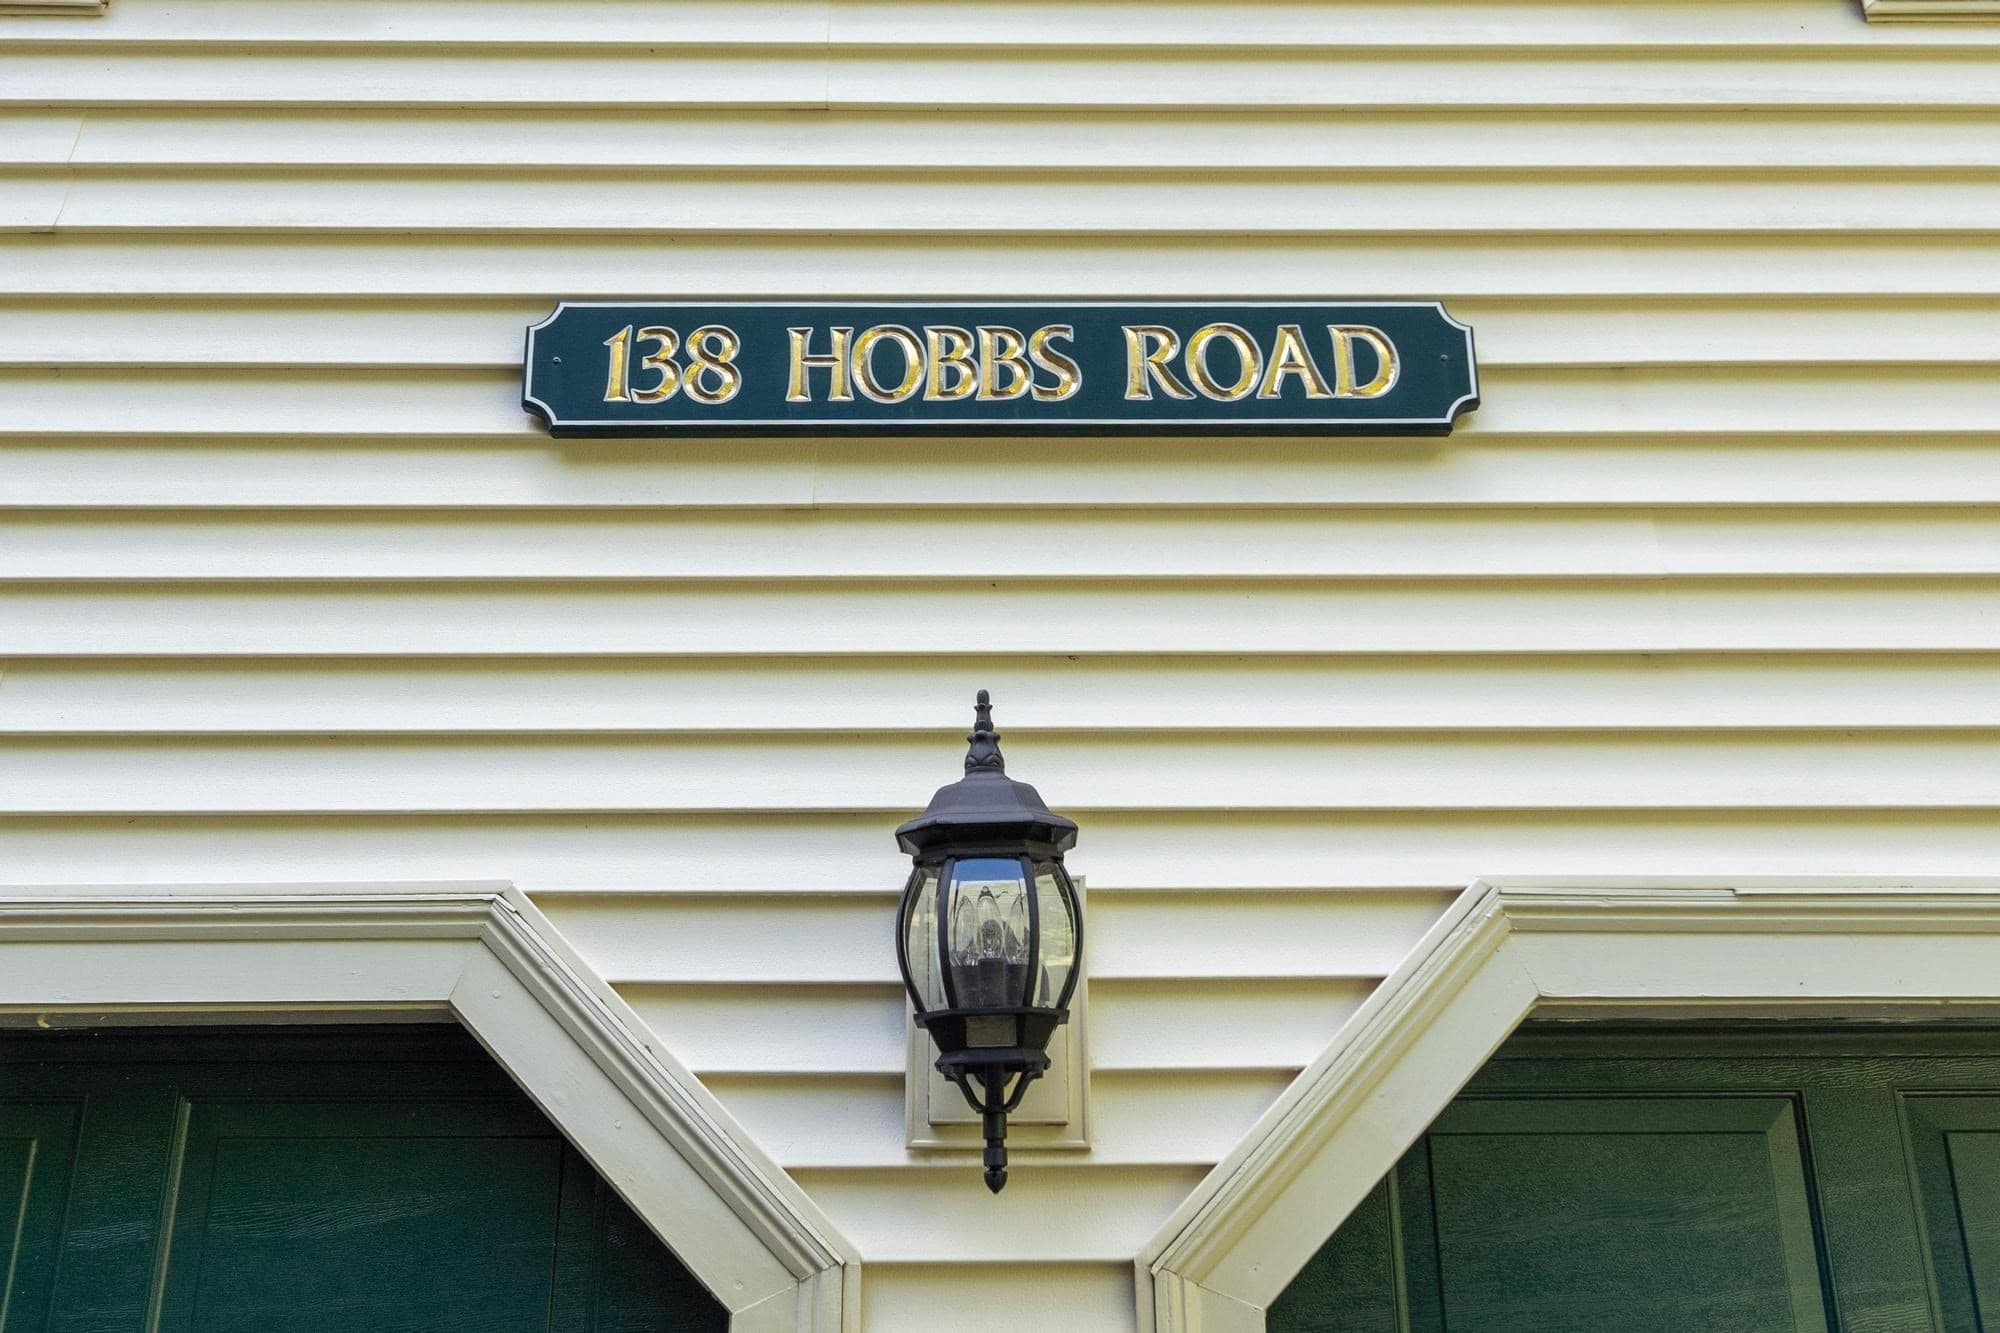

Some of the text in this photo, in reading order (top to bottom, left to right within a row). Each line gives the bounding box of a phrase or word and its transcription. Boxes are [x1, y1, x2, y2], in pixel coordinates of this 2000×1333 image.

[603, 323, 1400, 404] 138 HOBBS ROAD
